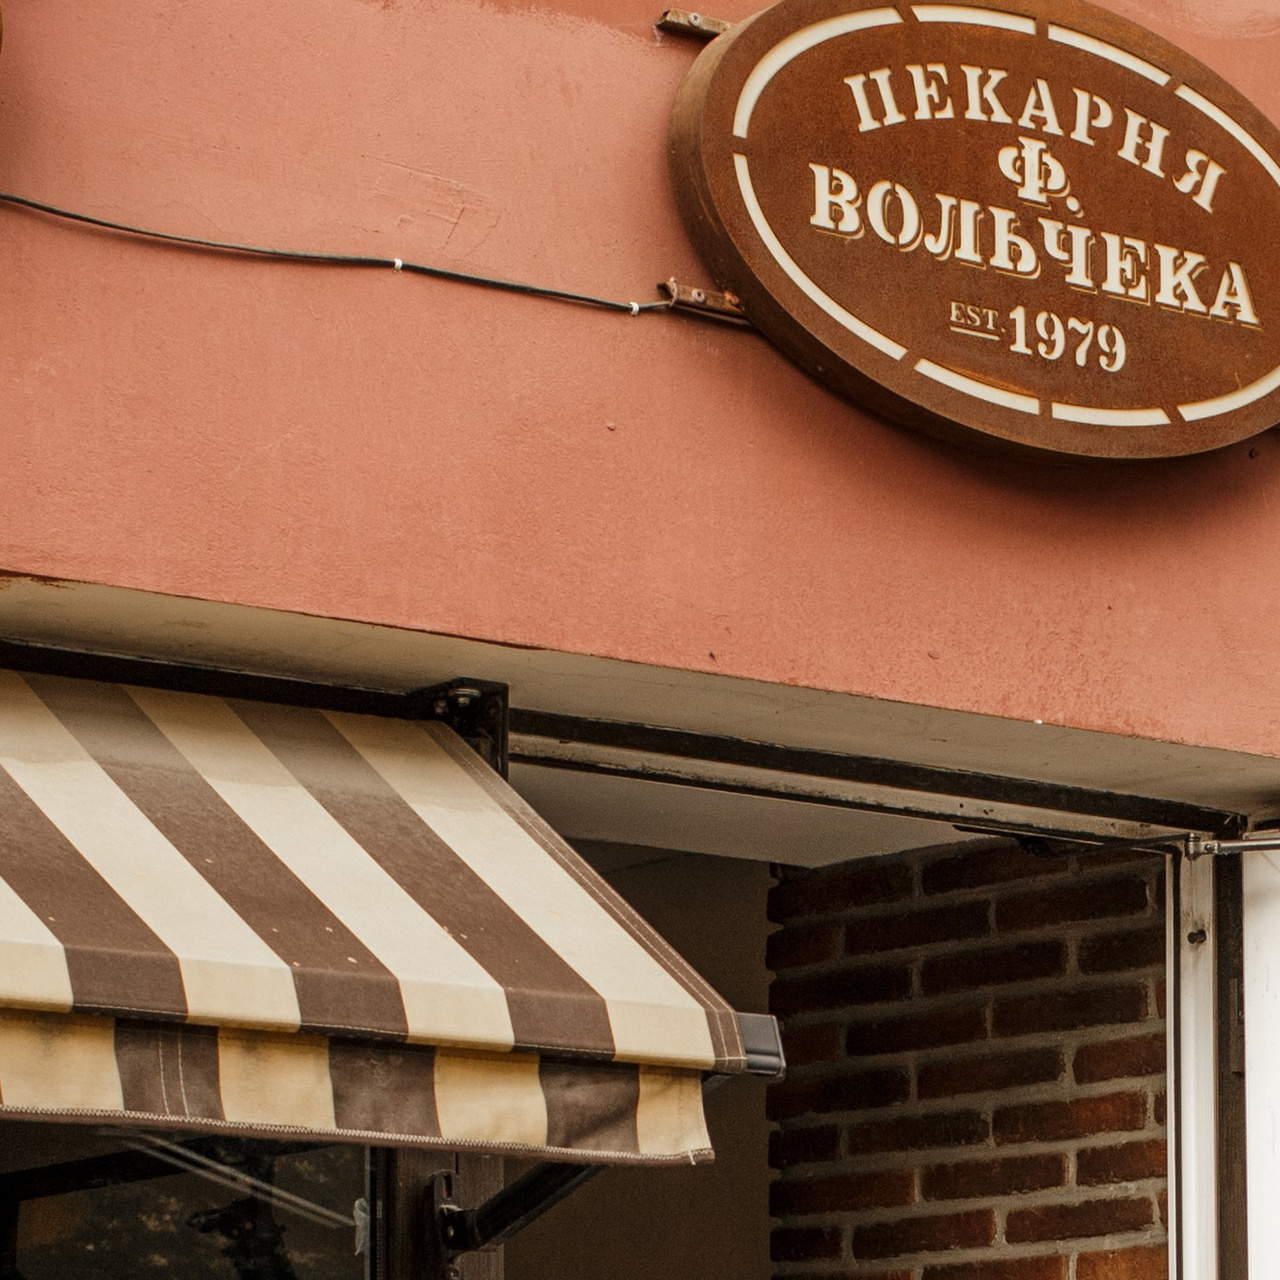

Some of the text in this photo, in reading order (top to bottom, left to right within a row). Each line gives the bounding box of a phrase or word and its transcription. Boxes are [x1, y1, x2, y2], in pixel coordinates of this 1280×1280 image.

[843, 61, 1228, 214] ПЕКАРНЯ
[998, 135, 1083, 217] Ф.
[808, 162, 1261, 330] ВОЛЬЧЕКА
[1008, 304, 1127, 373] 1979
